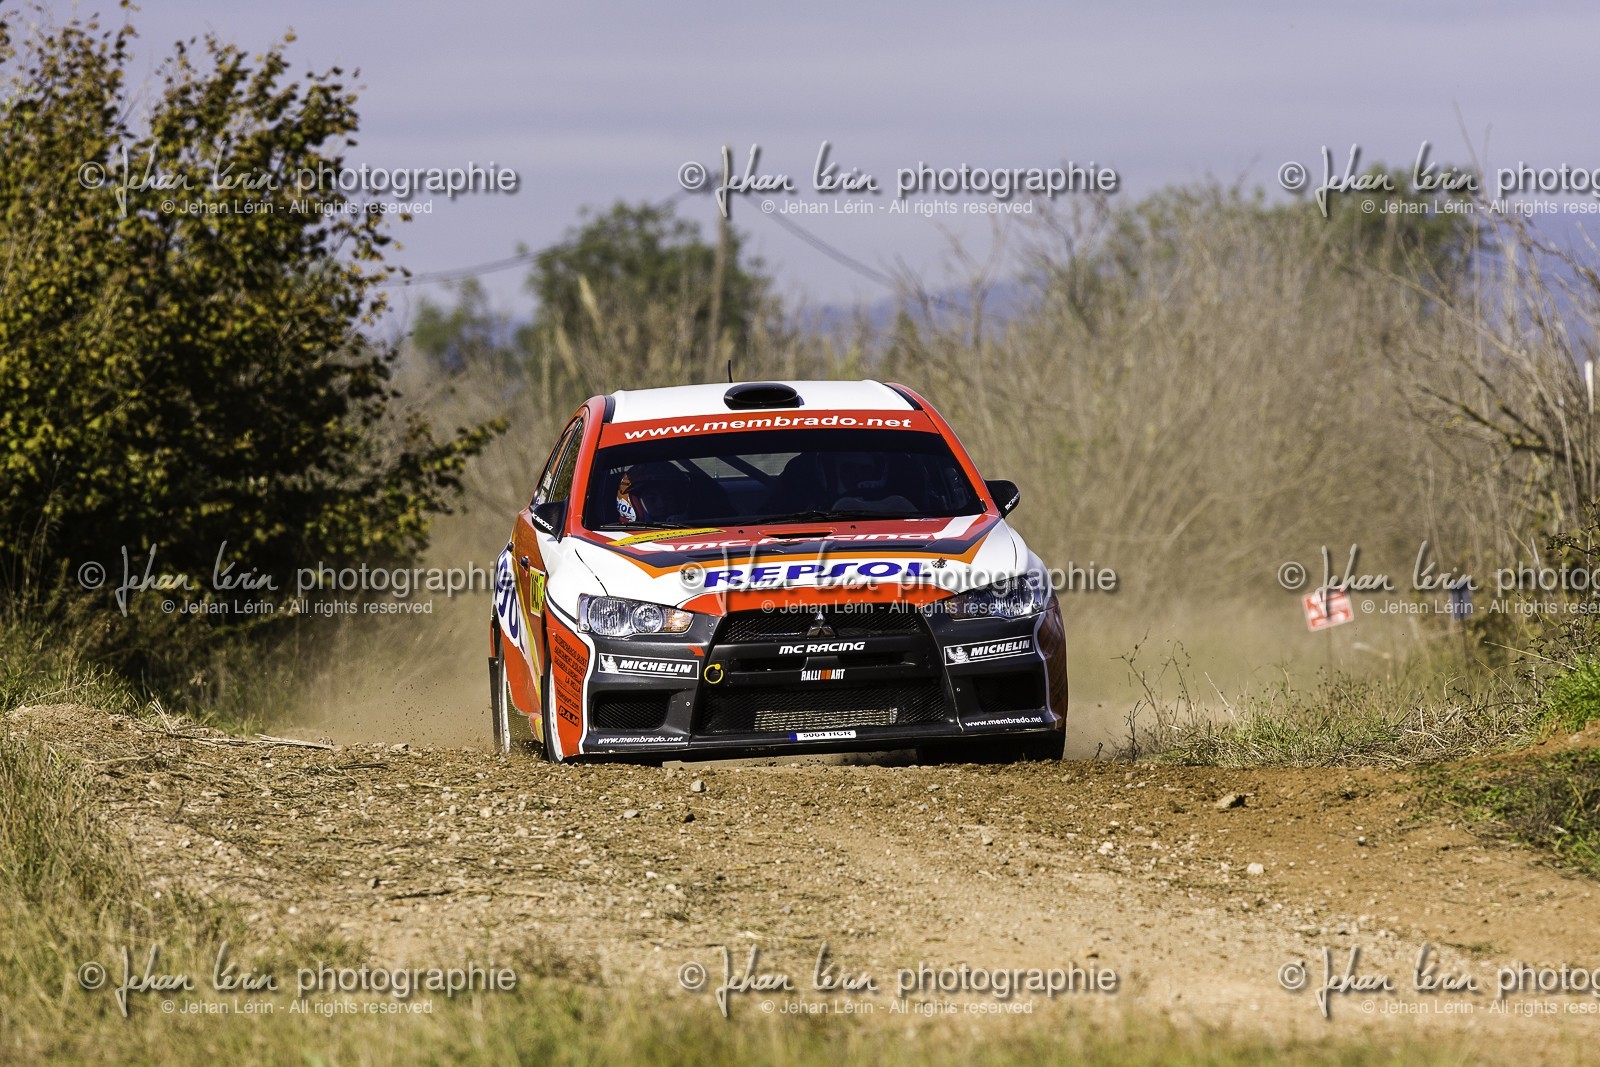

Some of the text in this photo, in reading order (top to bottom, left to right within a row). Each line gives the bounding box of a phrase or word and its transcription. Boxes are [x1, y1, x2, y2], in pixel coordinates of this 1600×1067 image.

[624, 415, 912, 440] www.membrado.net
[704, 561, 932, 588] REPSOL
[779, 642, 865, 655] MC RACING
[970, 640, 1030, 657] MICHELIN
[620, 660, 692, 673] MICHELIN
[965, 716, 1043, 727] www.membrado.net
[597, 736, 683, 745] www.membrado.net
